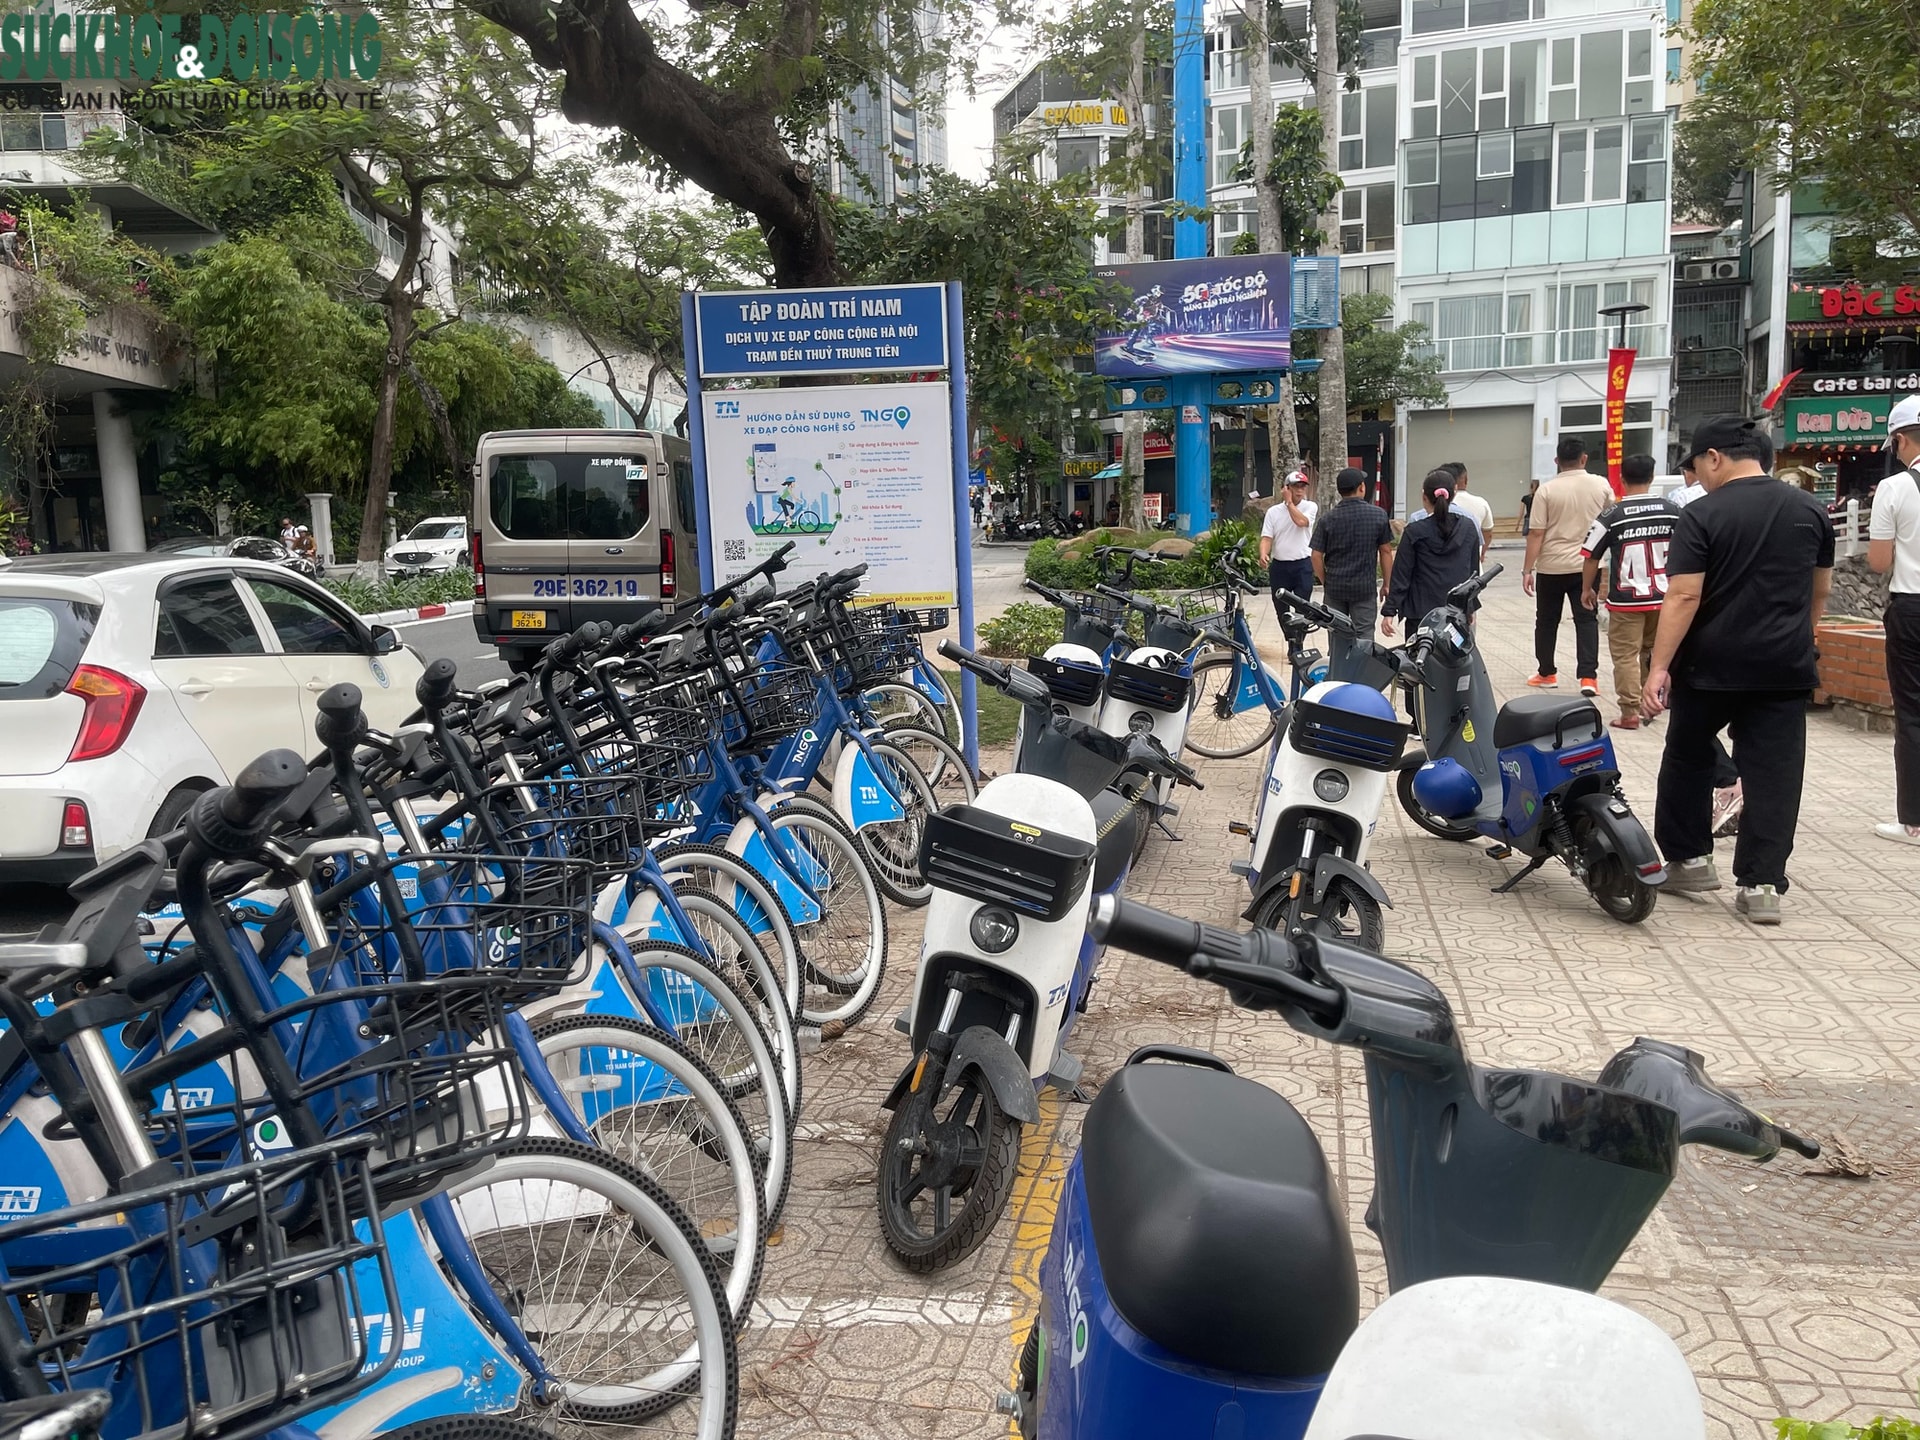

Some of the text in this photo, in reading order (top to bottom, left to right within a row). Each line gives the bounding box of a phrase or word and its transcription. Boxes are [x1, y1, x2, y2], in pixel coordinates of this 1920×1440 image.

[1214, 276, 1242, 294] TỐC
[1244, 271, 1267, 289] ĐỘ
[739, 296, 902, 325] TẬP ĐOÀN TRÍ NAM
[725, 324, 918, 346] DỊCH VỤ XE ĐẠP CÔNG CỘNG HÀ NỘI
[746, 351, 777, 365] TRẠM
[835, 346, 872, 360] TRUNG
[874, 344, 900, 358] TIÊN
[1896, 372, 1920, 390] cô
[715, 401, 740, 414] TN
[746, 411, 783, 422] HƯỚNG
[785, 410, 806, 421] DẪN
[823, 411, 851, 421] DỤNG
[743, 426, 756, 435] XE
[758, 425, 778, 436] ĐẠP
[780, 424, 811, 434] CÔNG
[813, 422, 840, 434] NGHỆ
[842, 420, 856, 431] SỐ
[600, 458, 614, 468] HỢP
[626, 470, 642, 479] IPT
[1639, 504, 1665, 512] SPECIAL
[1623, 525, 1672, 539] GLORIOUS
[1618, 540, 1670, 597] 45
[533, 579, 638, 597] 29E 362.19
[859, 786, 879, 800] TN
[348, 1308, 426, 1358] TN
[393, 1355, 426, 1370] ROUP
